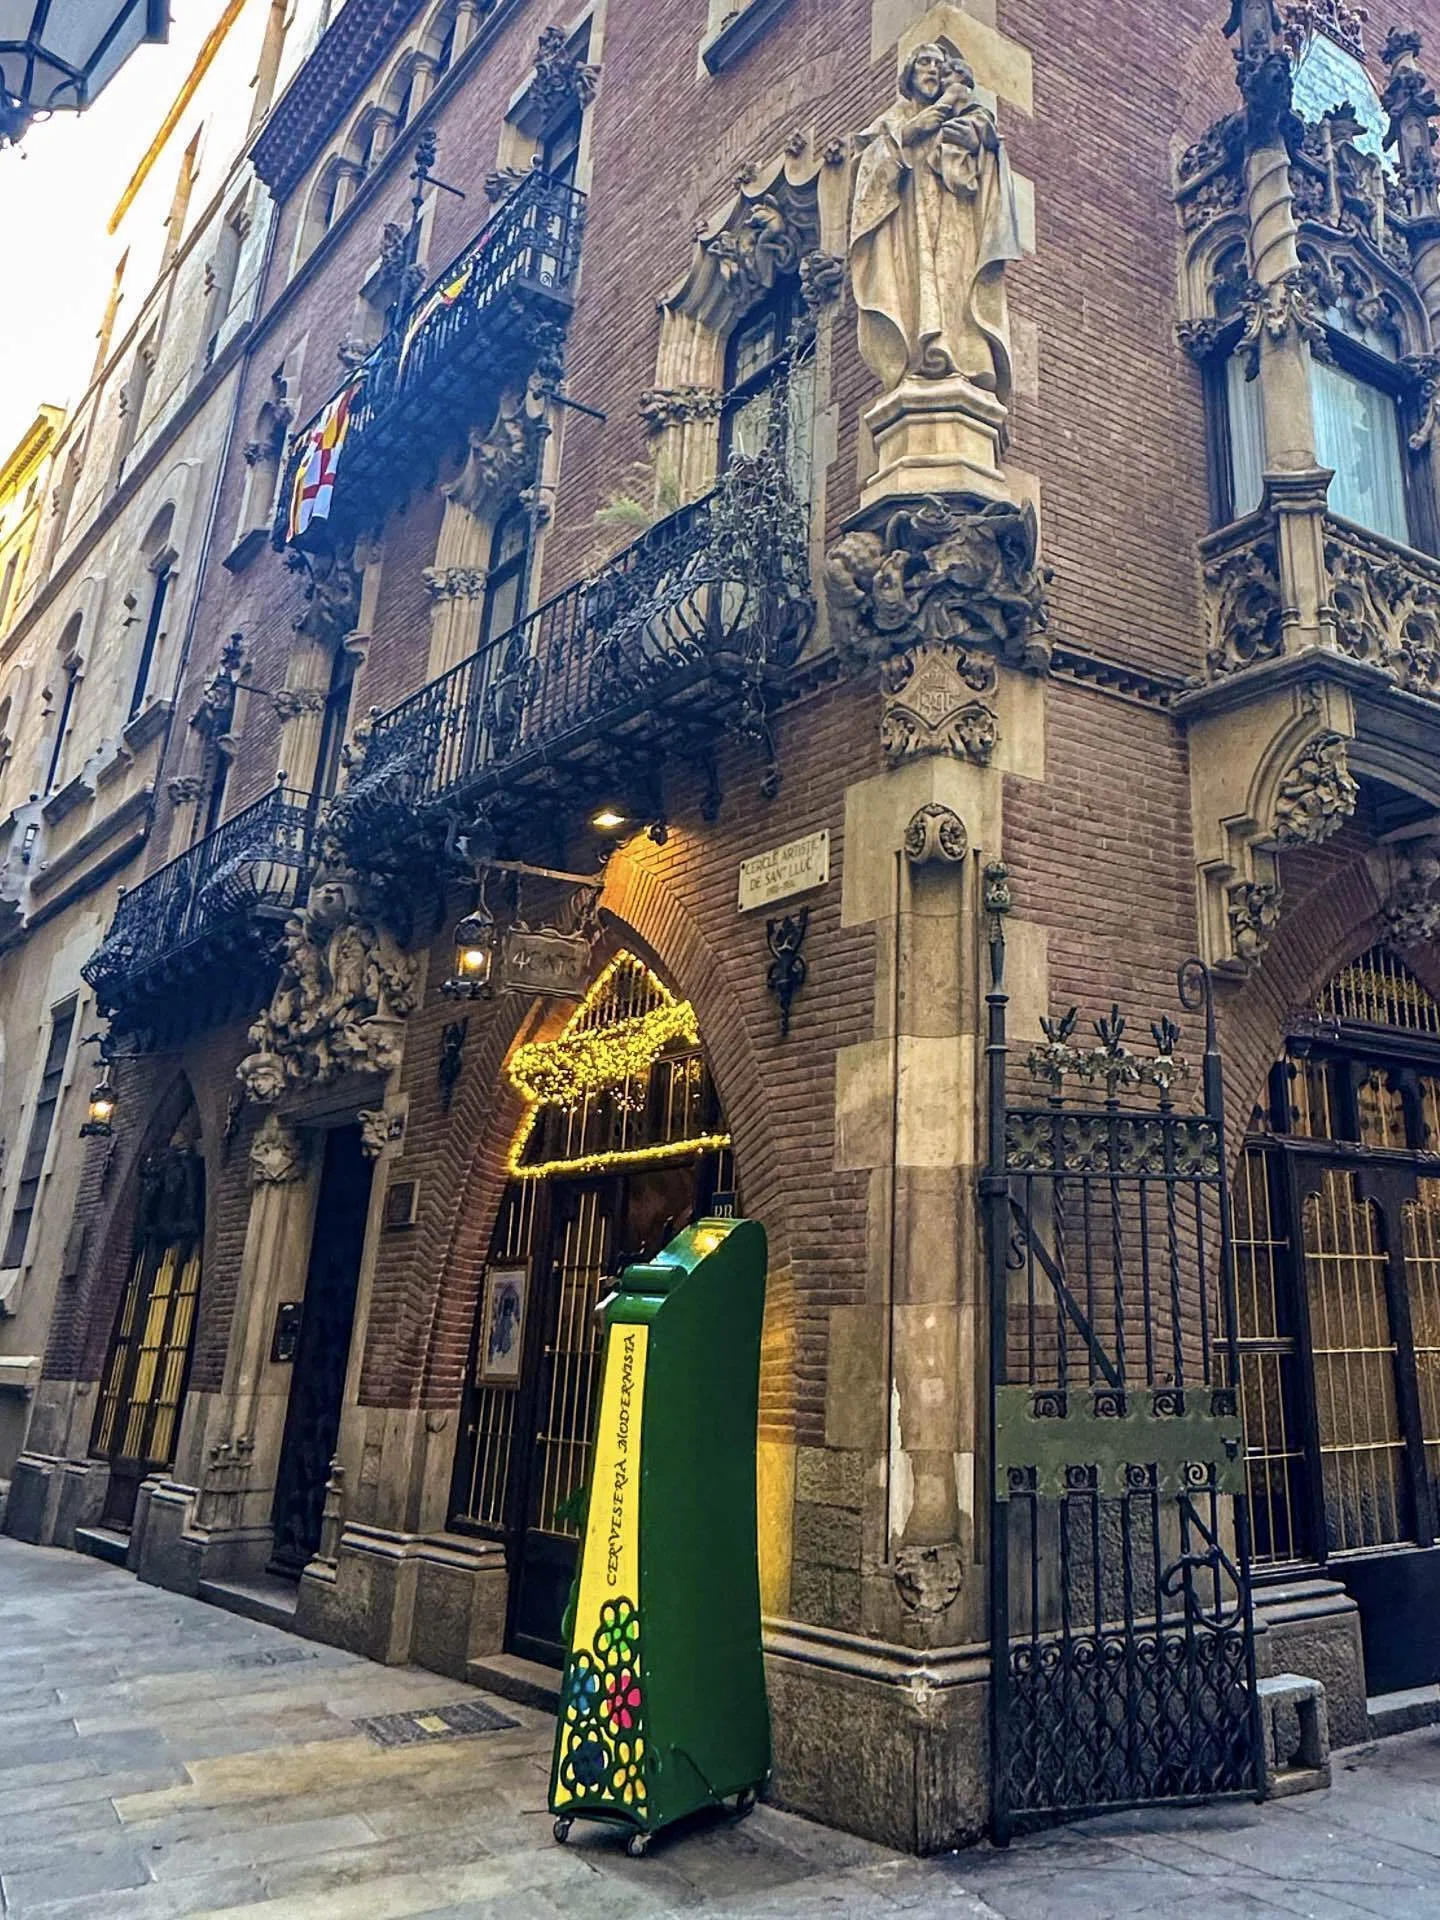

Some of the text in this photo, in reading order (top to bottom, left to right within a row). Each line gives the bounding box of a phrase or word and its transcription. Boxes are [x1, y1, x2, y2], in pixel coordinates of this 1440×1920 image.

[745, 850, 779, 875] CERCLE
[750, 876, 761, 891] DE
[789, 856, 813, 877] LLUC
[606, 1333, 636, 1586] CERVESERIA MODERNISTA
